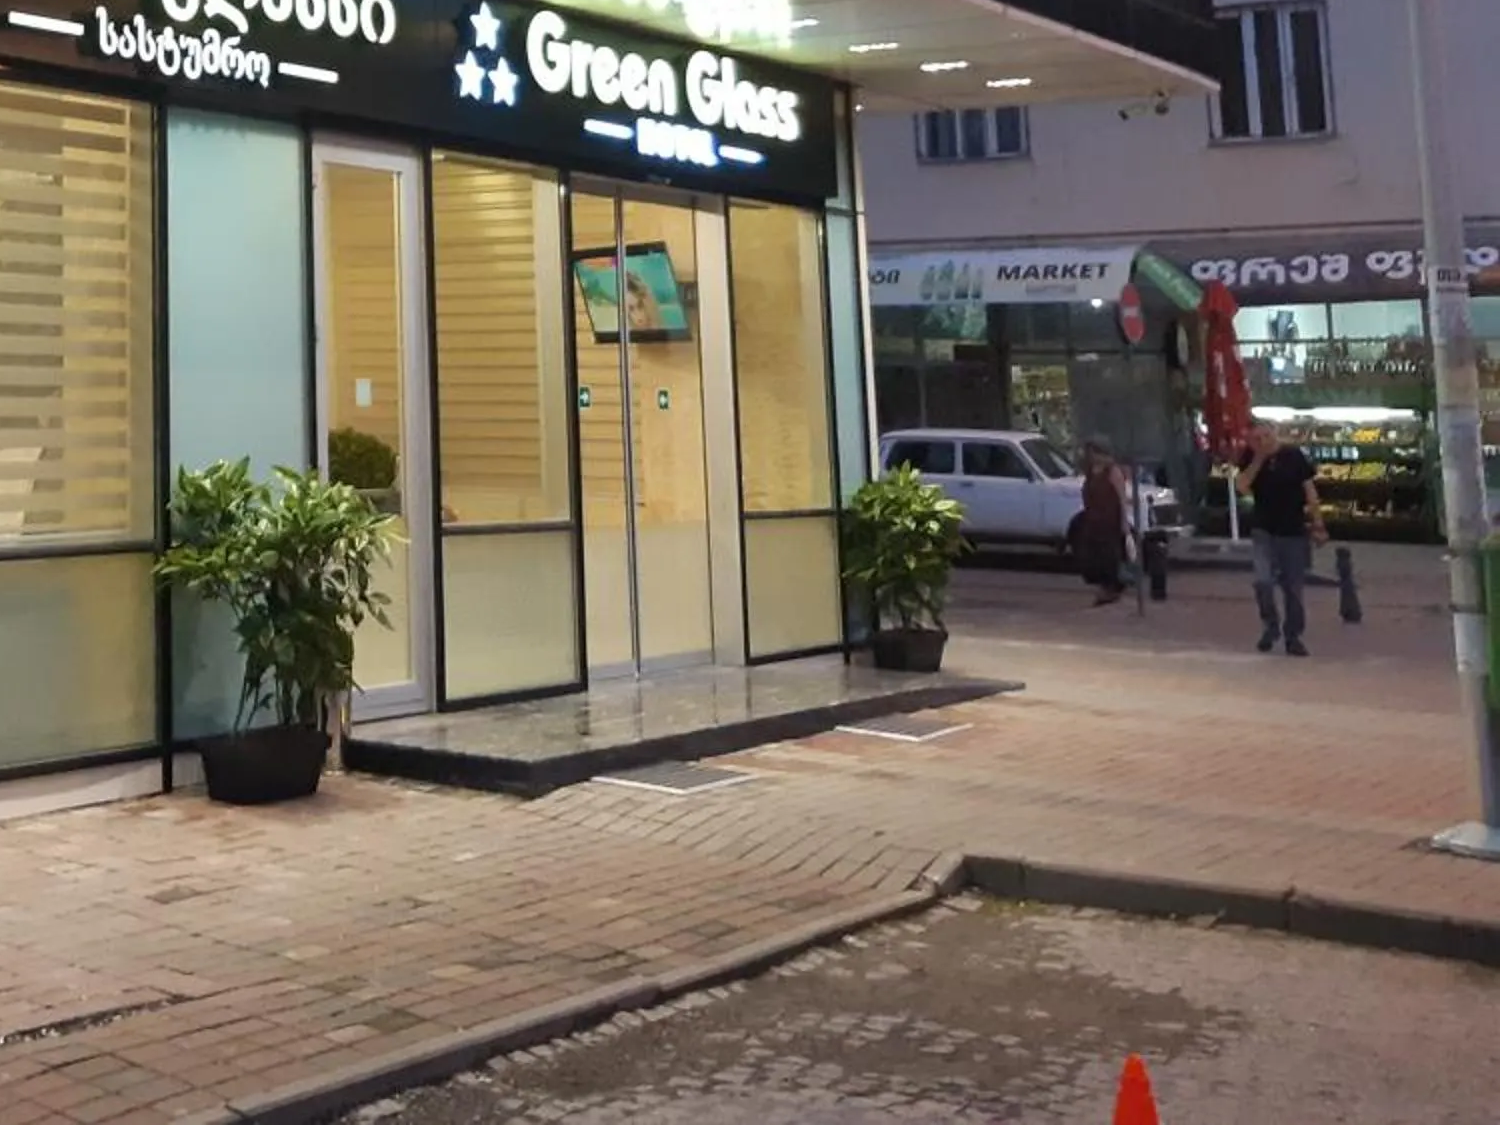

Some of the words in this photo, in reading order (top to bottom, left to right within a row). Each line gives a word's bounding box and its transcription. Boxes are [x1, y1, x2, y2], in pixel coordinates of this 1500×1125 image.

[94, 6, 272, 88] სასტუმრო
[526, 10, 678, 116] Green
[685, 50, 800, 141] Glass
[996, 262, 1110, 281] MARKET
[1191, 253, 1349, 286] ფრეშ
